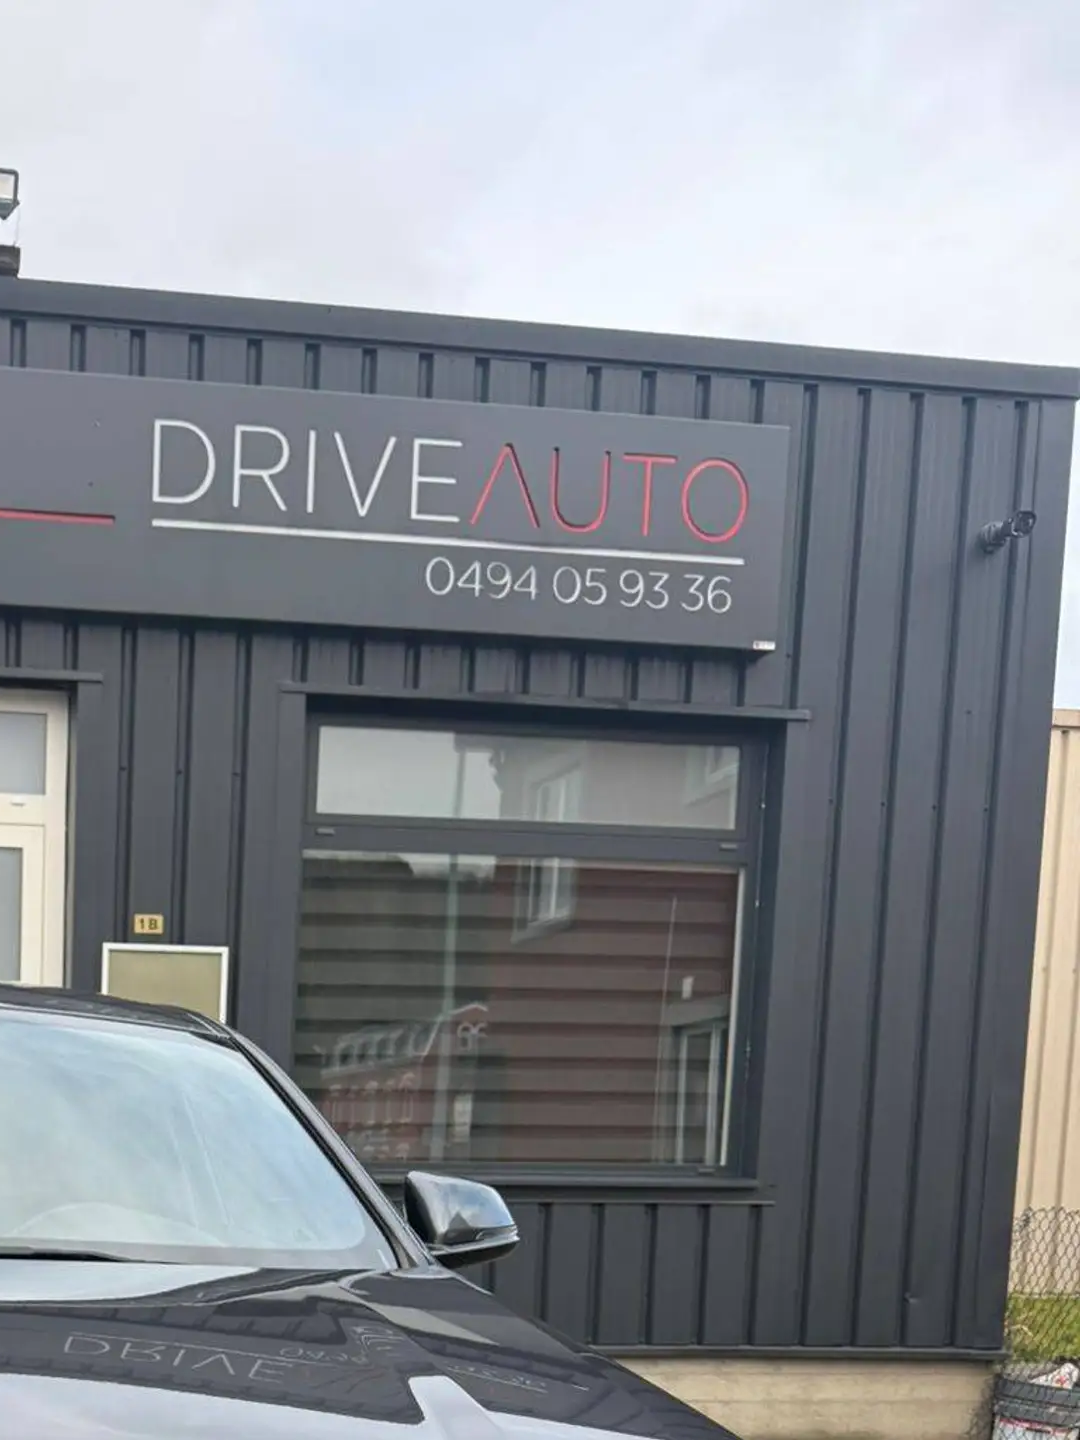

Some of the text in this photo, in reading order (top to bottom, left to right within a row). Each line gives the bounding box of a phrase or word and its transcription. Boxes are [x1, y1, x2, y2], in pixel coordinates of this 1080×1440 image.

[425, 556, 733, 614] 0494 05 93 36
